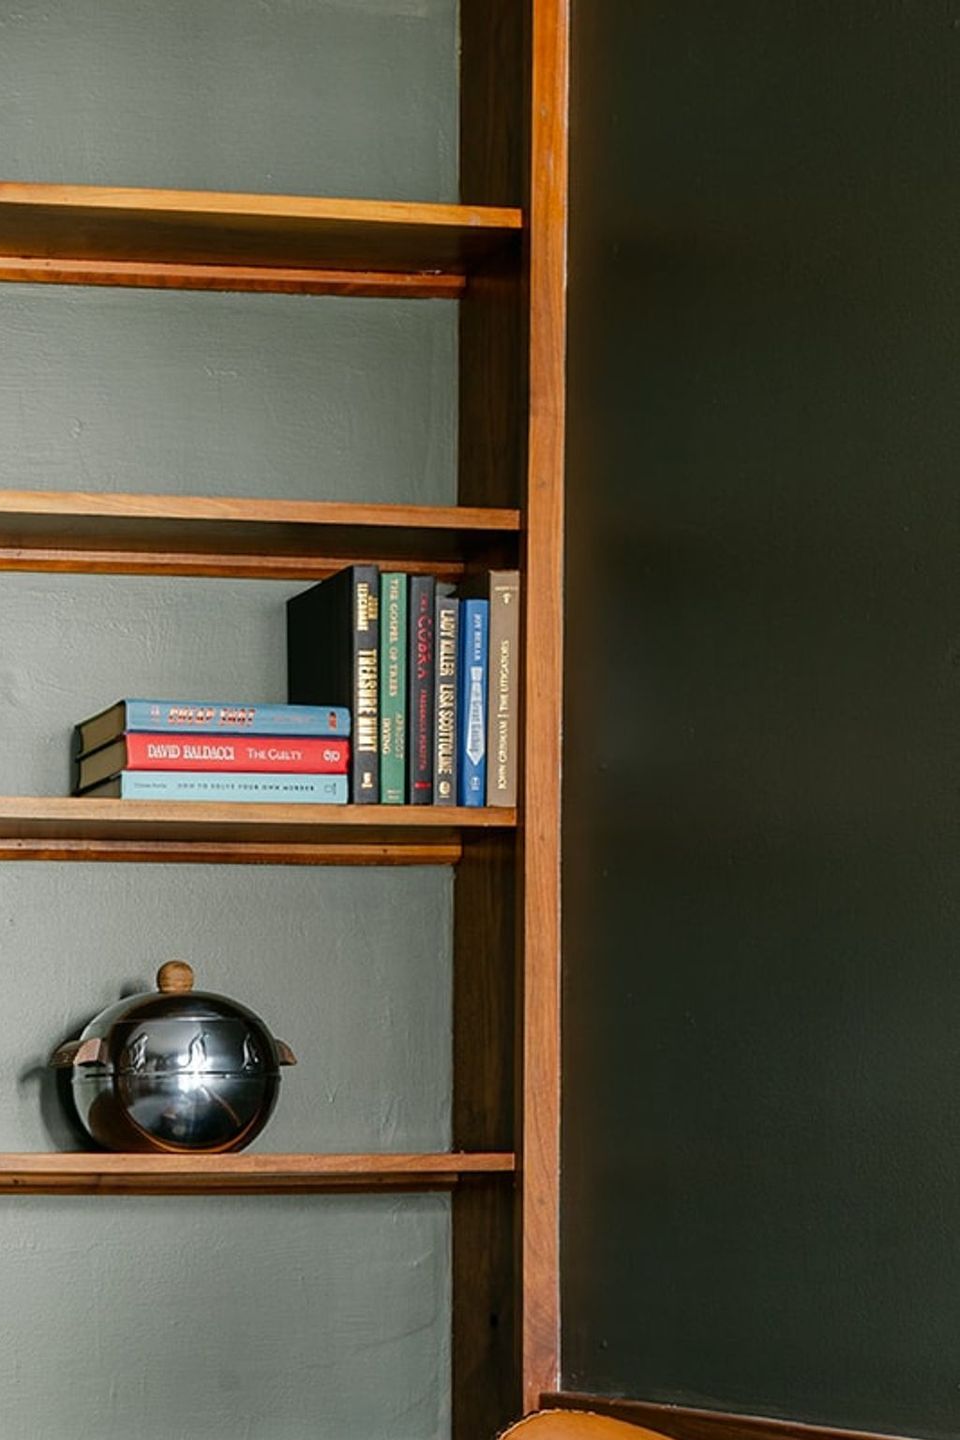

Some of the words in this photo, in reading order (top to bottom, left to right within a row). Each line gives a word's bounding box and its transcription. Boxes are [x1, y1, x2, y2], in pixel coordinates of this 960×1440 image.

[389, 578, 400, 600] THE
[389, 603, 400, 643] GOSPEL
[439, 610, 456, 637] LADY
[439, 638, 455, 677] KILLER
[499, 639, 510, 693] LITIGATORS
[358, 649, 378, 715] TREASURE
[388, 664, 400, 697] TREES
[438, 684, 455, 708] LISA
[498, 695, 509, 711] THE
[147, 744, 181, 760] DAVID
[183, 745, 236, 762] BALDACCI
[437, 710, 454, 775] SCOTTOLINE
[496, 764, 508, 790] JOHN
